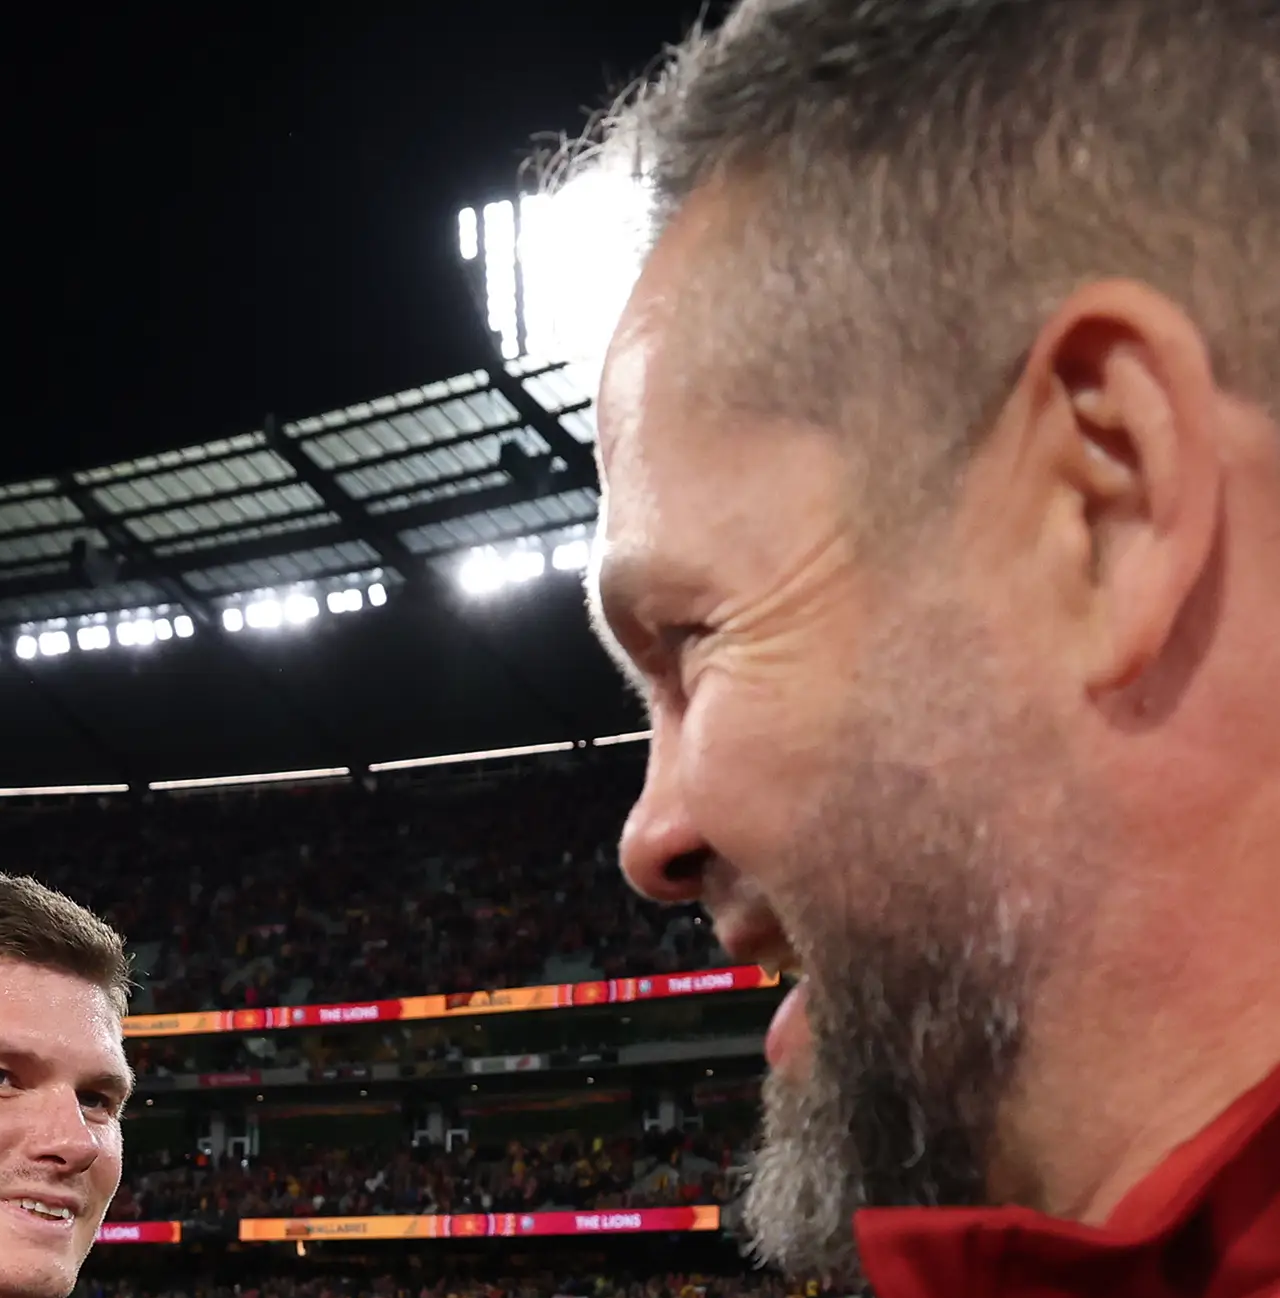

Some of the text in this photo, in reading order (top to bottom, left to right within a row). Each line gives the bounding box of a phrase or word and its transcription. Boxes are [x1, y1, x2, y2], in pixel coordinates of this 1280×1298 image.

[668, 972, 733, 993] THE LIONS
[319, 1005, 379, 1022] THE LIONS
[575, 1212, 641, 1231] THE LIONS
[103, 1226, 140, 1241] LIONS
